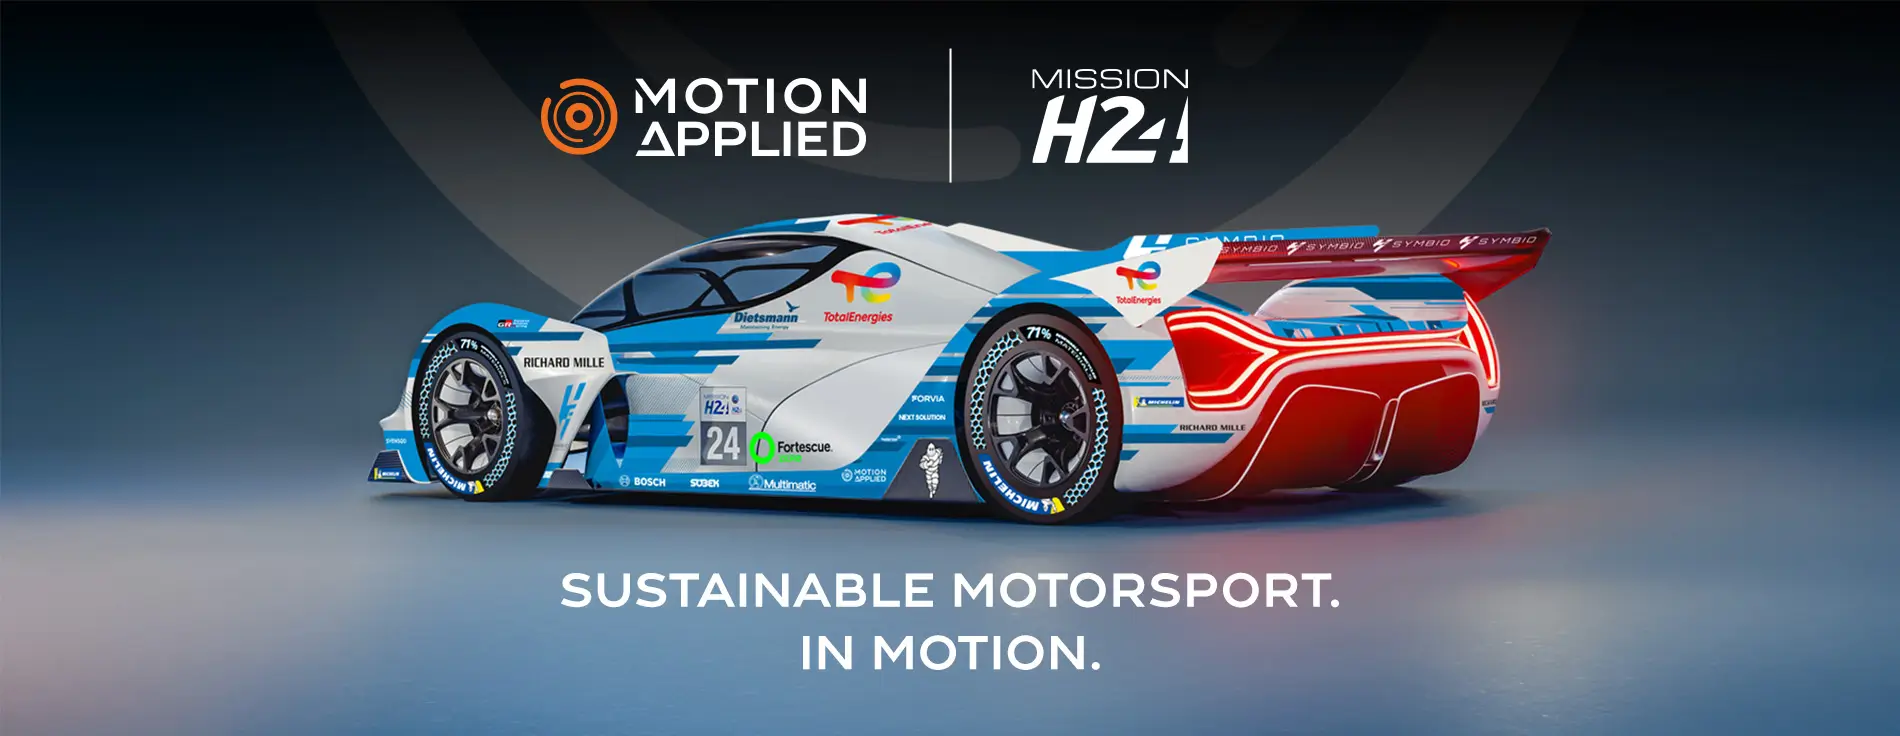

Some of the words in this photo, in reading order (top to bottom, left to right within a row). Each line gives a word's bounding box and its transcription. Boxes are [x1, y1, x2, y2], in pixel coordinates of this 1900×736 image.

[1392, 239, 1450, 248] SYMBIO
[1480, 236, 1537, 245] SYMBIO
[1221, 244, 1279, 254] SYMBIO
[1305, 242, 1365, 251] SYMBIO
[1115, 296, 1161, 306] TotalEnergies
[734, 312, 798, 323] Dietsmann
[823, 311, 893, 324] TotalEnergies
[1026, 326, 1052, 340] 71%
[460, 339, 478, 350] 71%
[523, 357, 570, 368] RICHARD
[573, 357, 605, 368] MILLE
[706, 426, 741, 460] 24
[427, 447, 467, 492] MICHELIN
[634, 477, 666, 487] BOSCH
[763, 478, 817, 491] Multimatic
[983, 460, 1040, 512] MICHELIN
